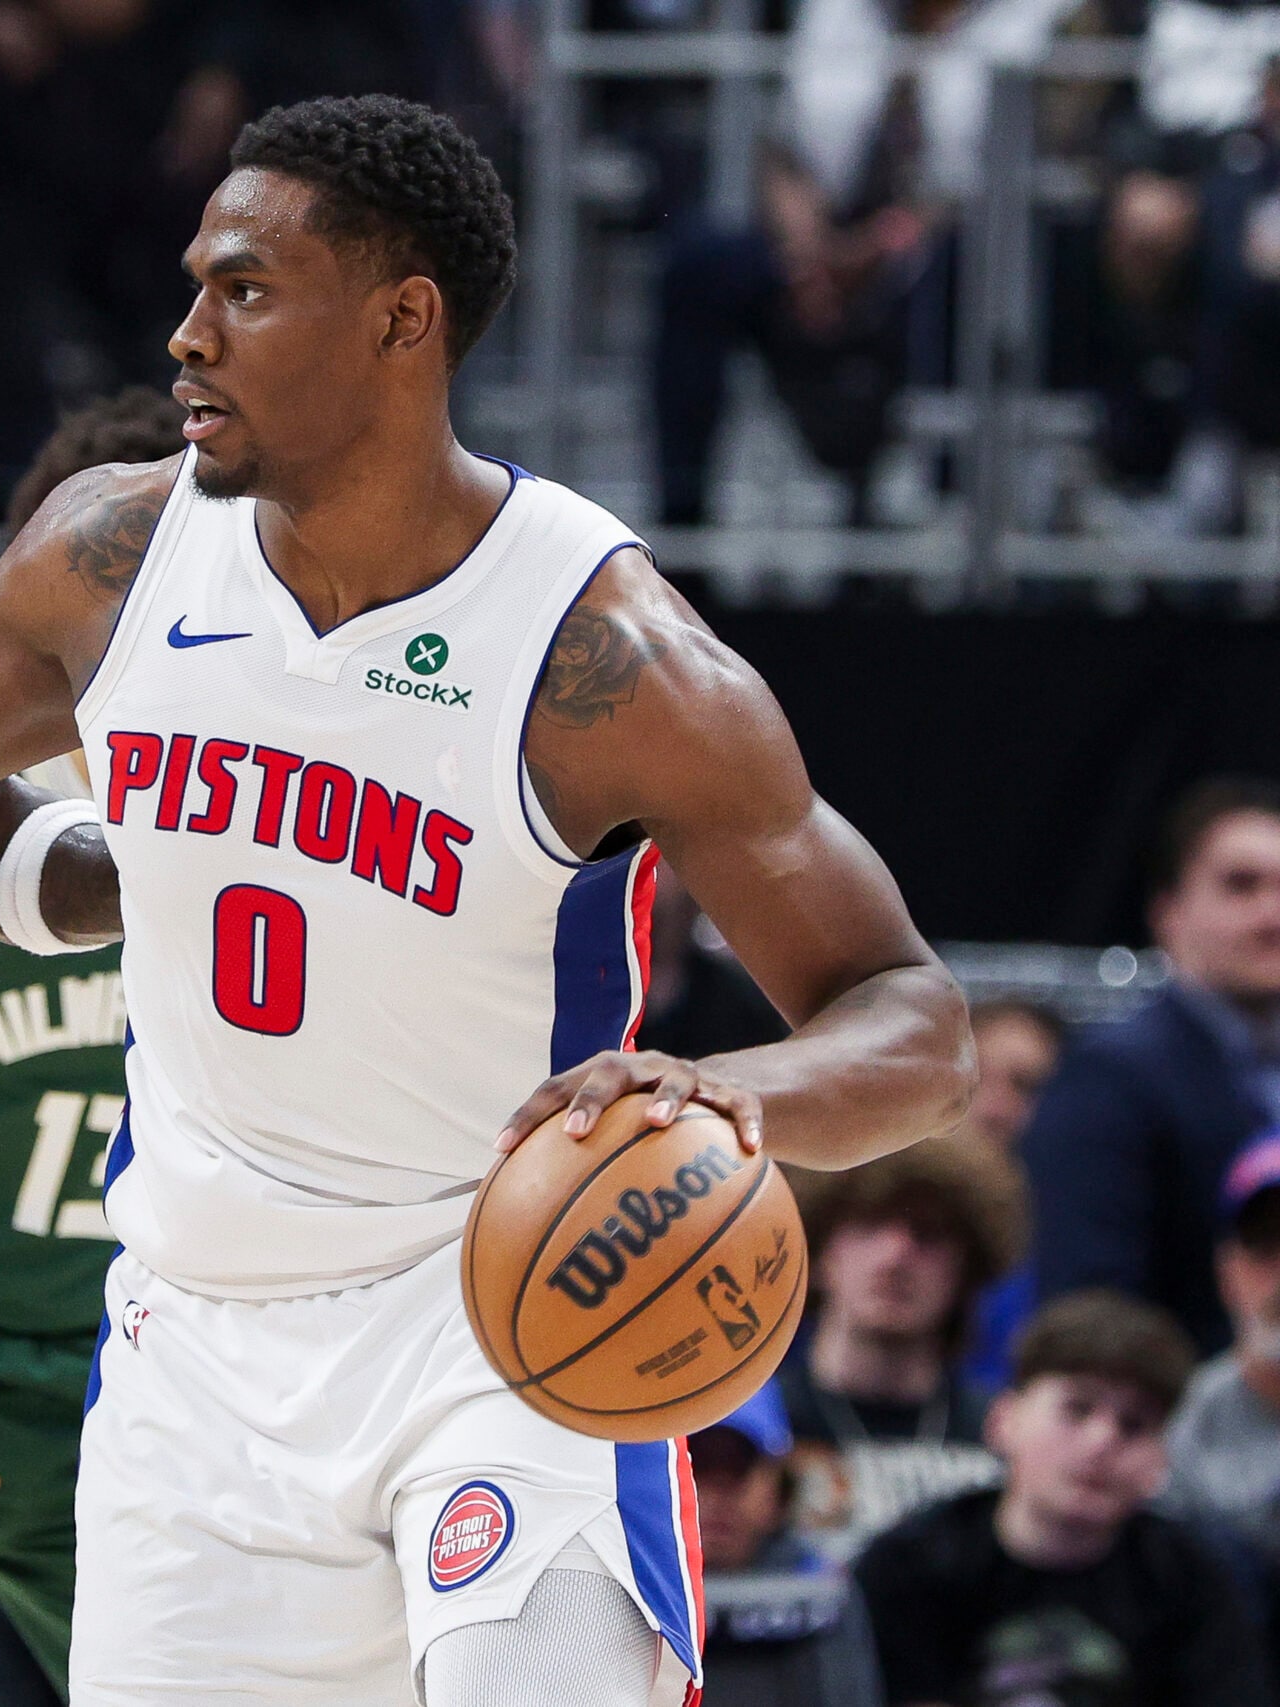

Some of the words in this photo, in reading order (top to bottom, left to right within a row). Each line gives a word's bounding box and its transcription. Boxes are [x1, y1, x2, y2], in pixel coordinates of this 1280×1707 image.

[364, 668, 472, 710] StockX
[106, 730, 474, 917] PISTONS
[212, 882, 308, 1037] 0
[545, 1144, 745, 1310] Wilson
[437, 1531, 491, 1563] PISTONS
[441, 1513, 494, 1544] DETROIT
